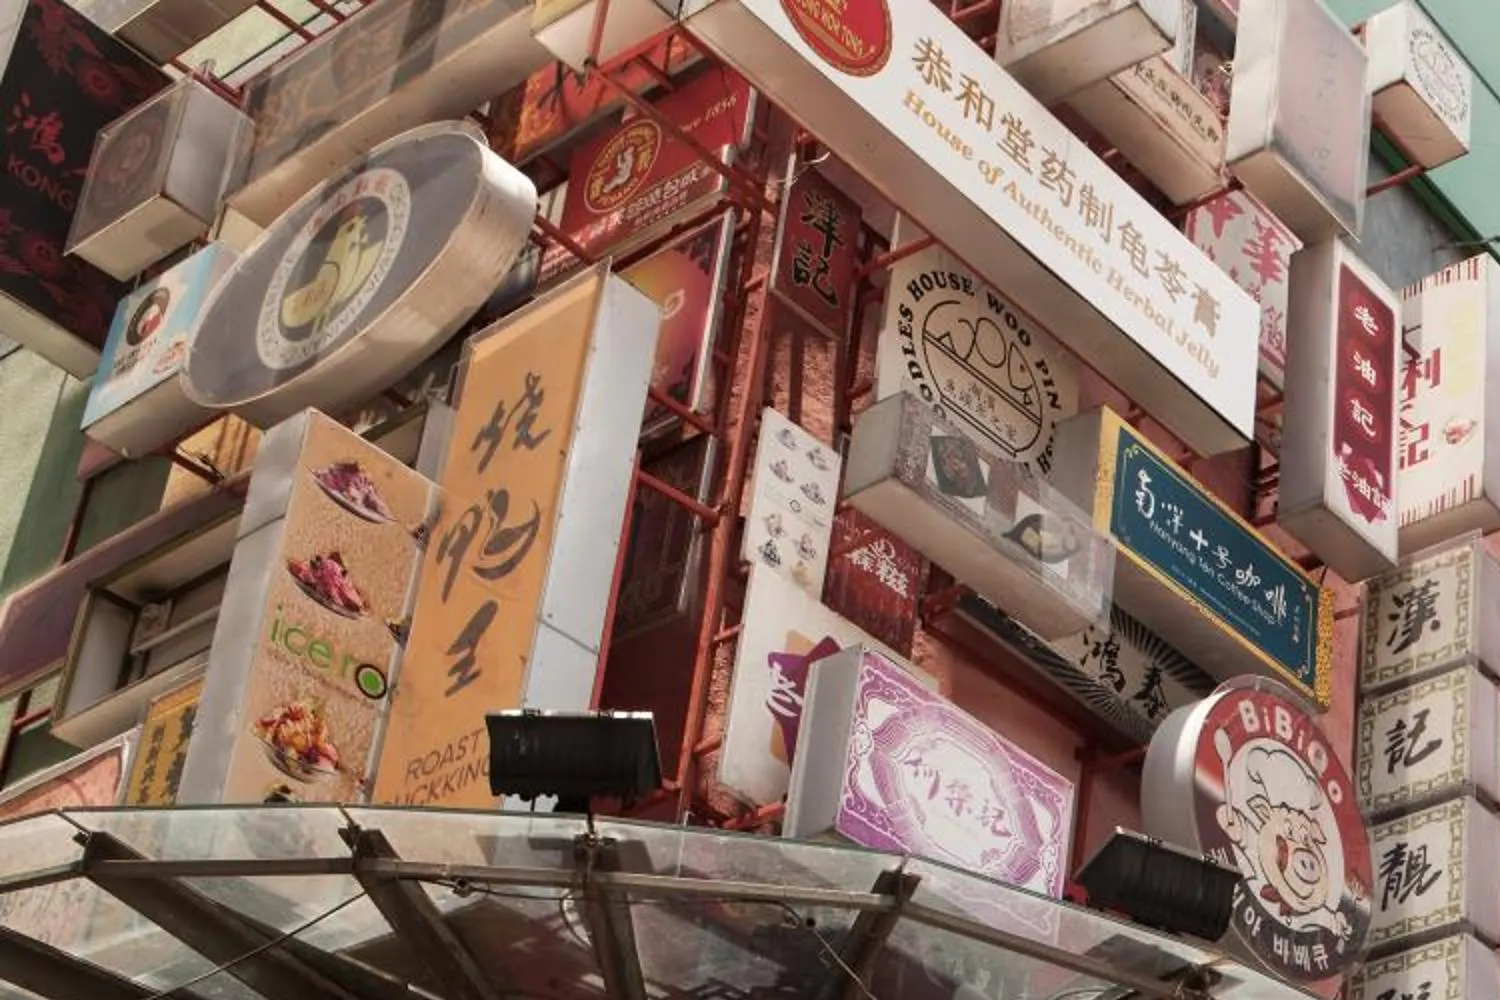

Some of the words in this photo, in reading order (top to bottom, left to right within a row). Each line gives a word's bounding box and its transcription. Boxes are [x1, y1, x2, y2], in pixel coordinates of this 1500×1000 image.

[909, 35, 1224, 340] 恭和堂药制龟苓膏
[903, 90, 974, 161] House
[977, 157, 1004, 186] of
[1004, 180, 1103, 277] Authentic
[1106, 269, 1177, 346] Herbal
[1177, 326, 1222, 381] Jelly
[906, 270, 976, 302] HOUSE
[985, 291, 1032, 349] WOO
[897, 304, 948, 422] OODLES
[404, 728, 486, 786] ROAST
